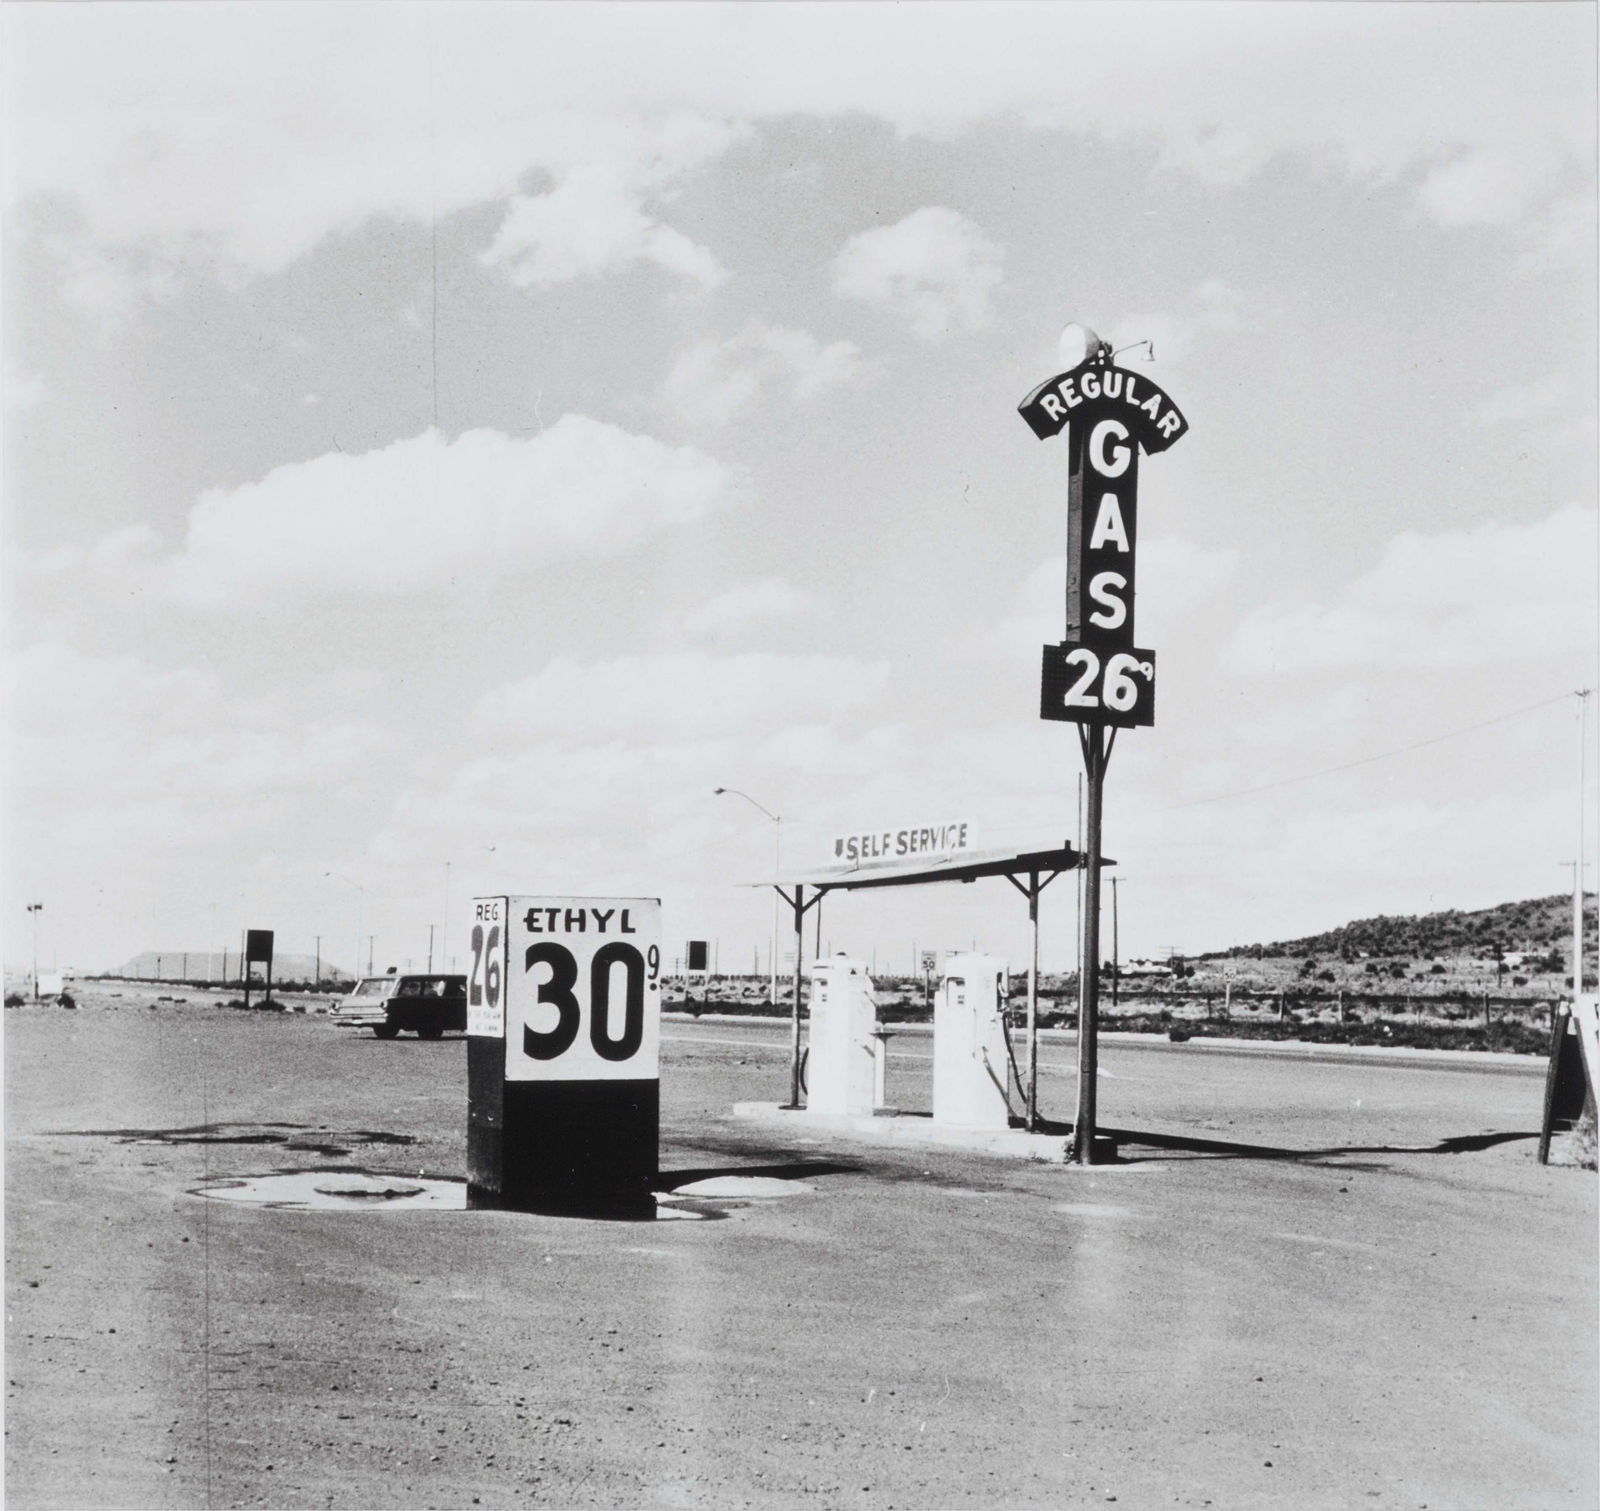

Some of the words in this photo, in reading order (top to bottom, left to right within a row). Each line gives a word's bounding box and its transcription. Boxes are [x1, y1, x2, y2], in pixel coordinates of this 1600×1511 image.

[1039, 370, 1181, 439] REGULAR
[1088, 418, 1132, 630] GAS
[846, 832, 891, 860] SELF
[895, 823, 968, 856] SERVICE
[523, 907, 636, 934] ETHYL
[469, 924, 501, 1009] 26
[923, 960, 936, 969] 50
